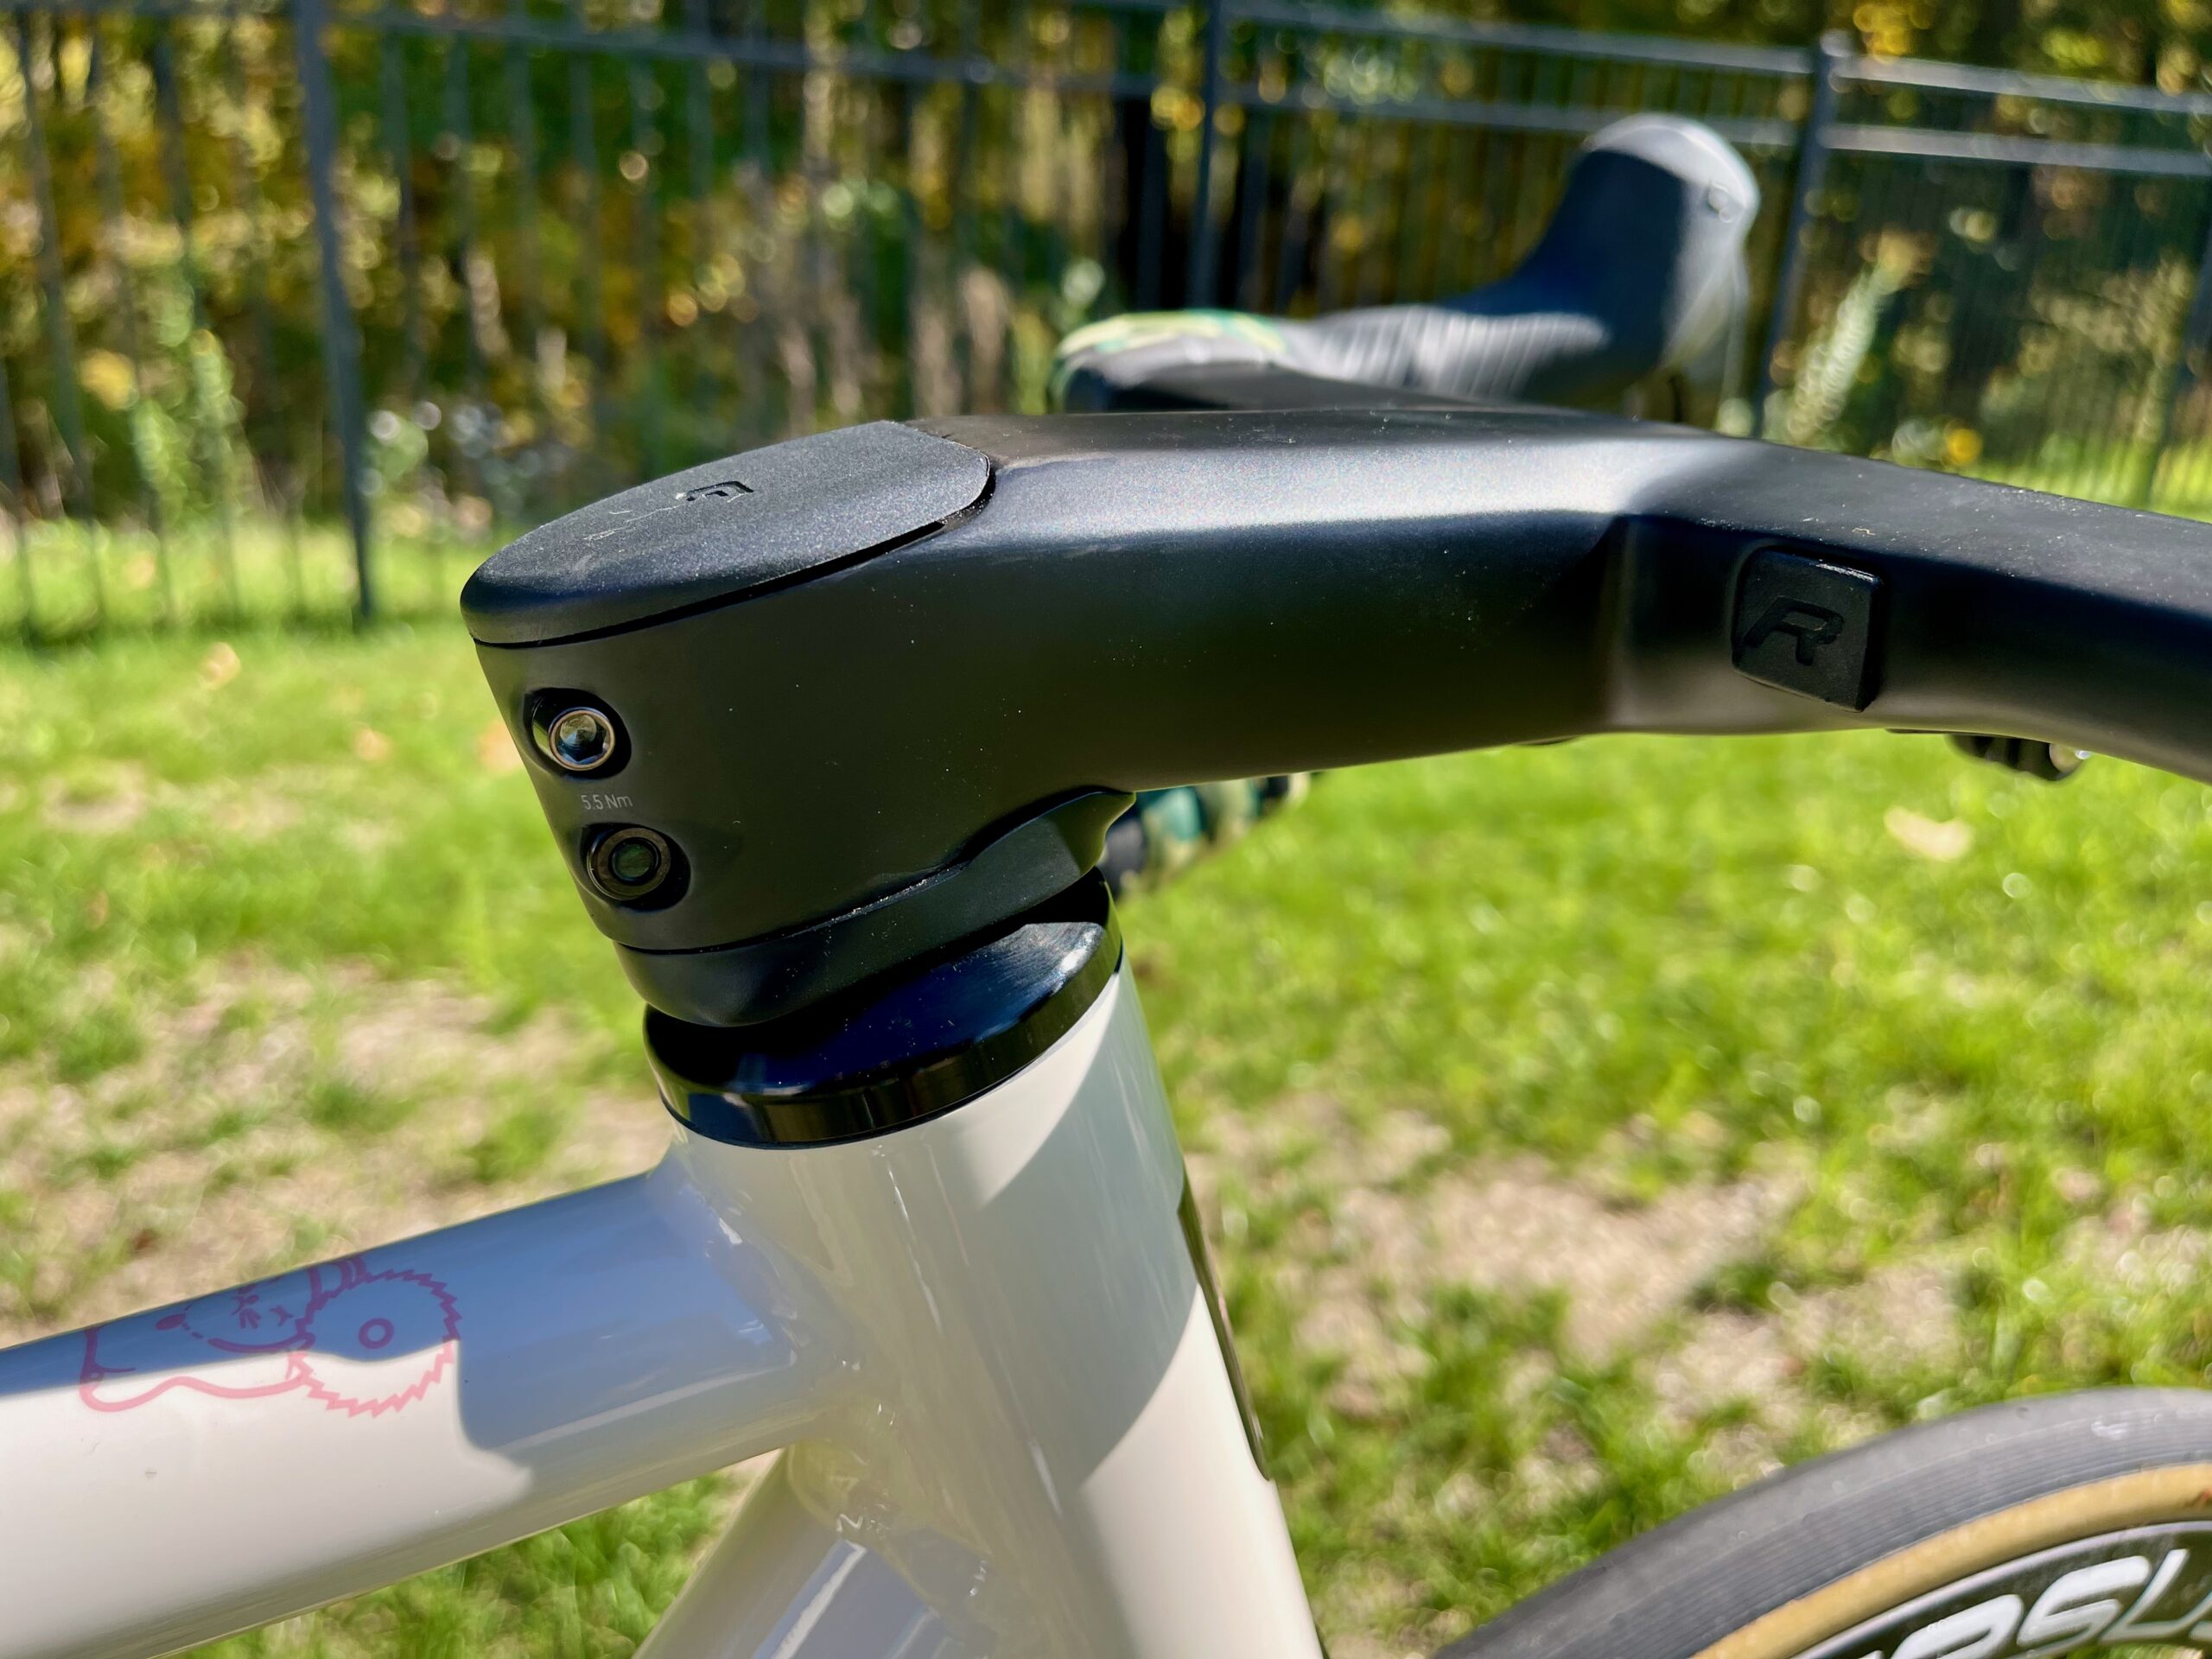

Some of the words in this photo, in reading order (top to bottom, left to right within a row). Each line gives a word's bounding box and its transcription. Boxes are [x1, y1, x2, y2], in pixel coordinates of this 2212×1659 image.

[1741, 594, 1845, 666] R
[581, 794, 603, 810] 5.5
[605, 794, 633, 809] Nm
